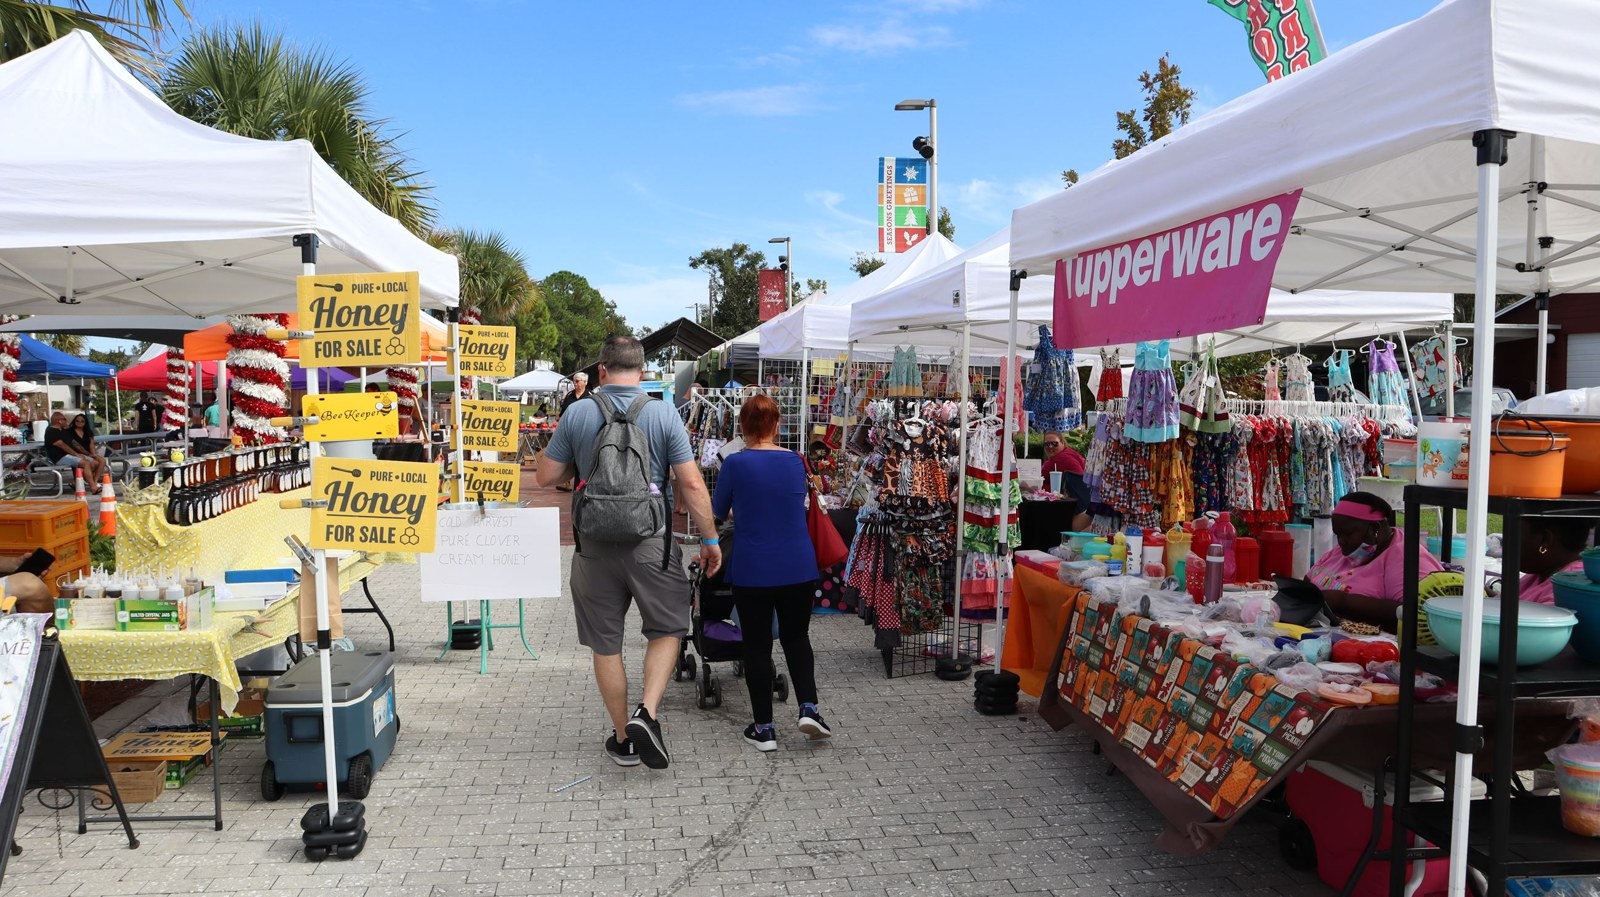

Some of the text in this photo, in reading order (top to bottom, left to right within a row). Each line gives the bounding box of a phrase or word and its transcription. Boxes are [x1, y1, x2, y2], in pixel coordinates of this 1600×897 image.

[1063, 202, 1283, 307] Tupperware
[351, 281, 409, 294] PURE LOCAL
[309, 296, 409, 335] Honey
[314, 338, 382, 358] FOR SALE
[459, 337, 509, 360] Honey
[460, 361, 493, 371] OR SALE
[461, 412, 512, 436] Honey
[463, 436, 496, 447] OR SALE
[370, 471, 427, 484] PURE LOCAL
[464, 473, 513, 498] Honey
[324, 480, 427, 525] Honey
[439, 516, 462, 528] COLD
[325, 524, 396, 544] FOR SALE
[476, 534, 520, 546] CLOVER
[439, 553, 530, 565] CREAM HONEY
[121, 738, 209, 748] Honey
